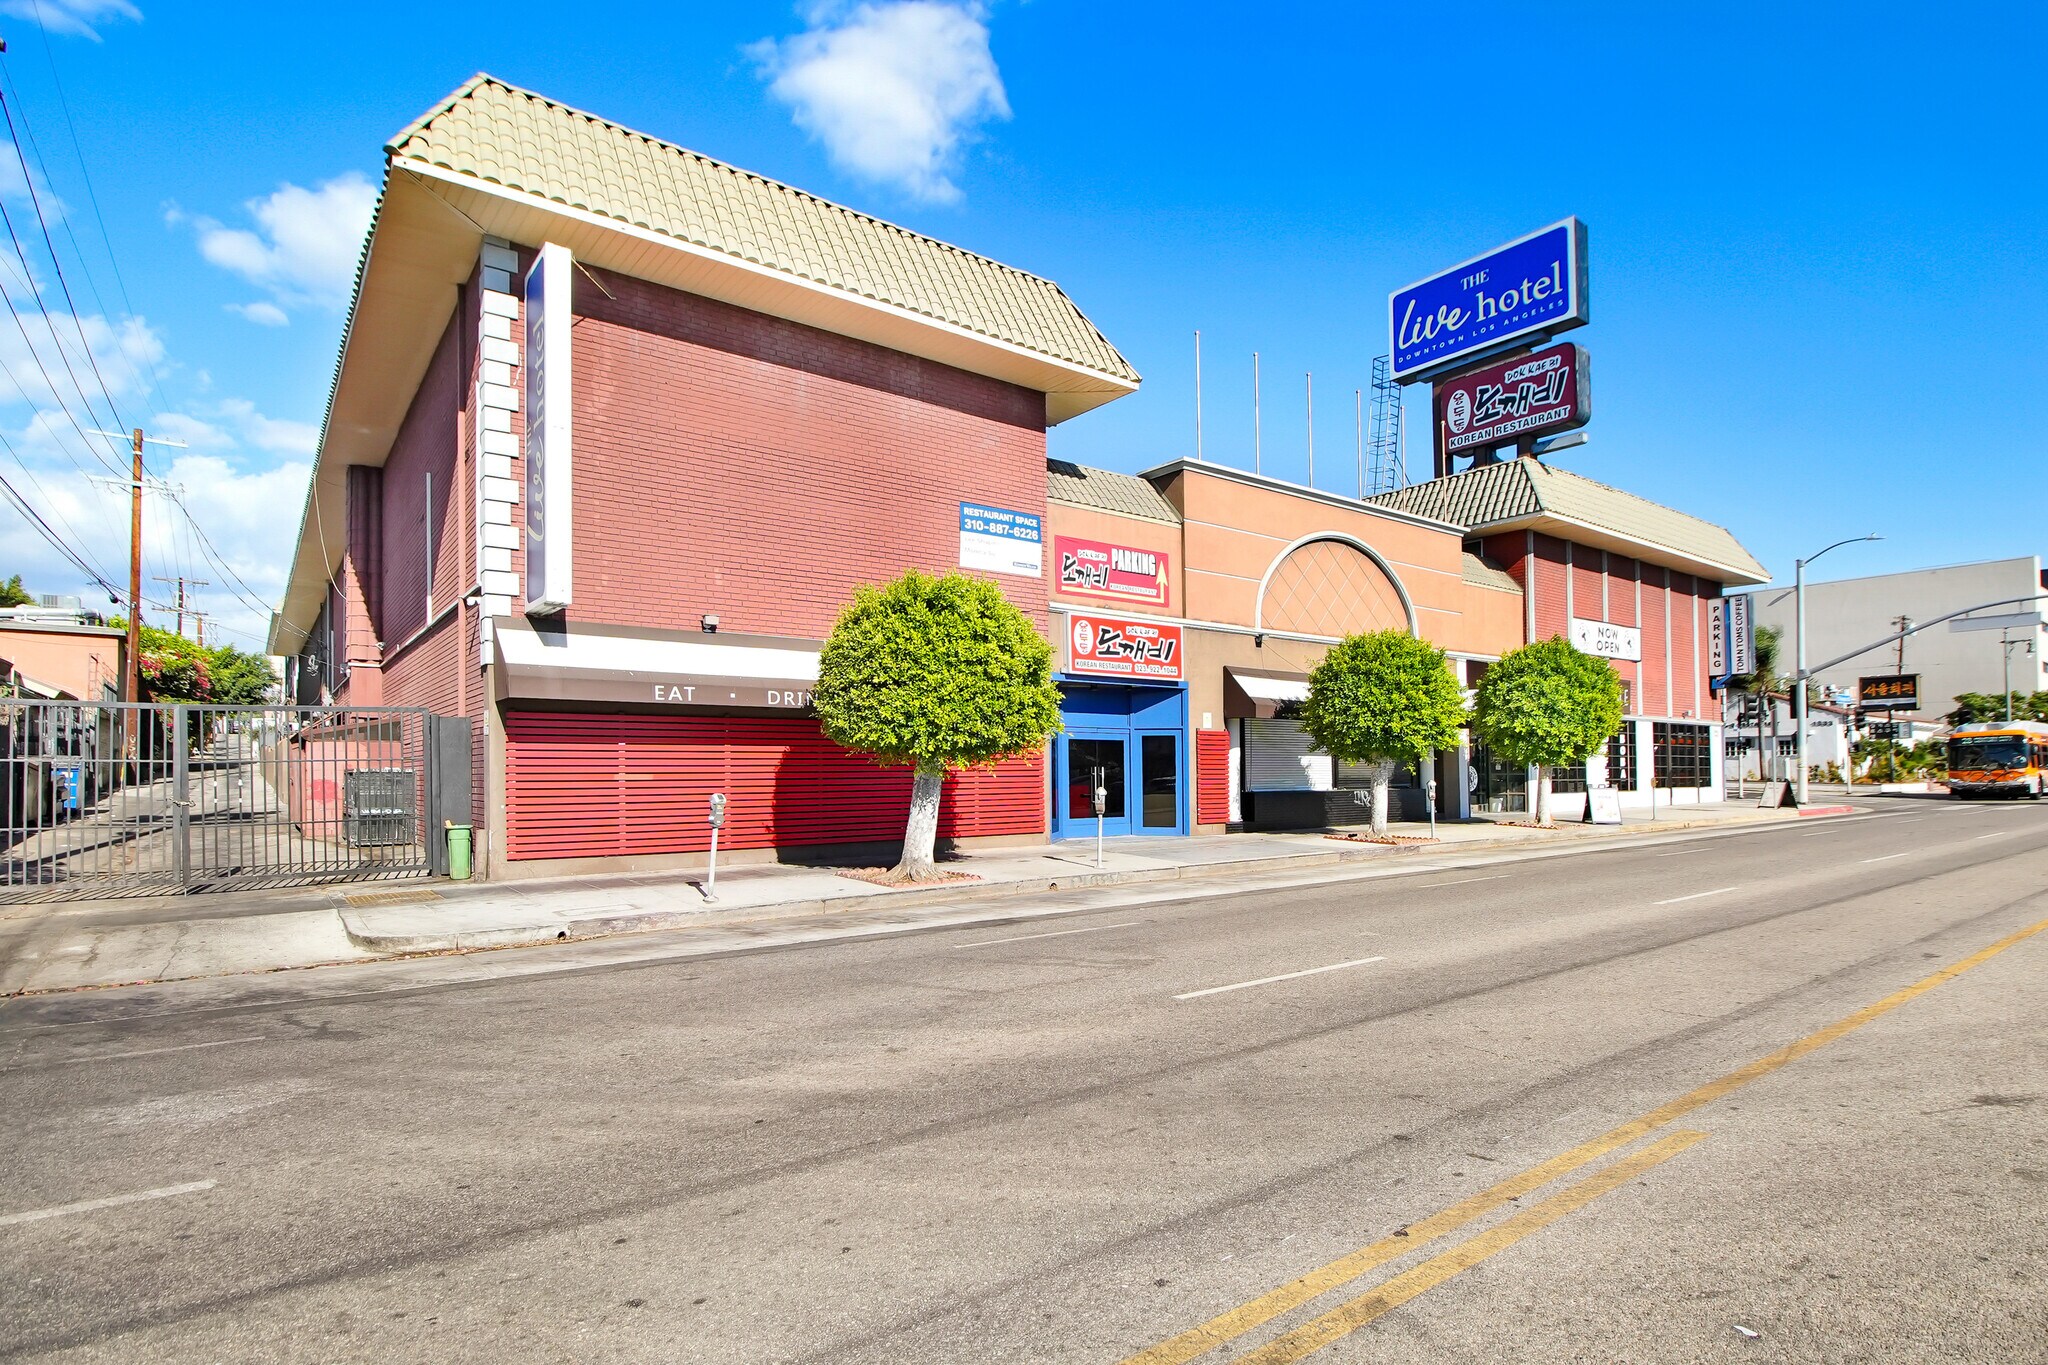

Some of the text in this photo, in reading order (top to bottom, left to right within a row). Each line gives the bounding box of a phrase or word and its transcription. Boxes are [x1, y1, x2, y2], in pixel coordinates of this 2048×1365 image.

[1460, 269, 1489, 290] THE
[1476, 260, 1563, 323] hotel
[1398, 299, 1564, 364] DOWNTOWN LOS ANGELES
[533, 311, 544, 432] hotel
[1507, 367, 1527, 382] DOK
[1474, 368, 1569, 425] 도깨비
[1450, 406, 1570, 448] KOREAN RESTAURANT
[963, 507, 1038, 527] RESTAURANT SPACE
[964, 519, 1039, 540] 310-887-6226
[1063, 554, 1109, 587] 도깨비
[1112, 548, 1156, 577] PARKING
[1097, 628, 1174, 661] 도깨비
[1596, 640, 1620, 653] OPEN
[1598, 627, 1619, 640] NOW
[1712, 605, 1721, 668] PARKING
[1076, 661, 1098, 669] KOREAN
[1098, 662, 1132, 671] RESTAURANT
[654, 685, 819, 706] EAT DRIN
